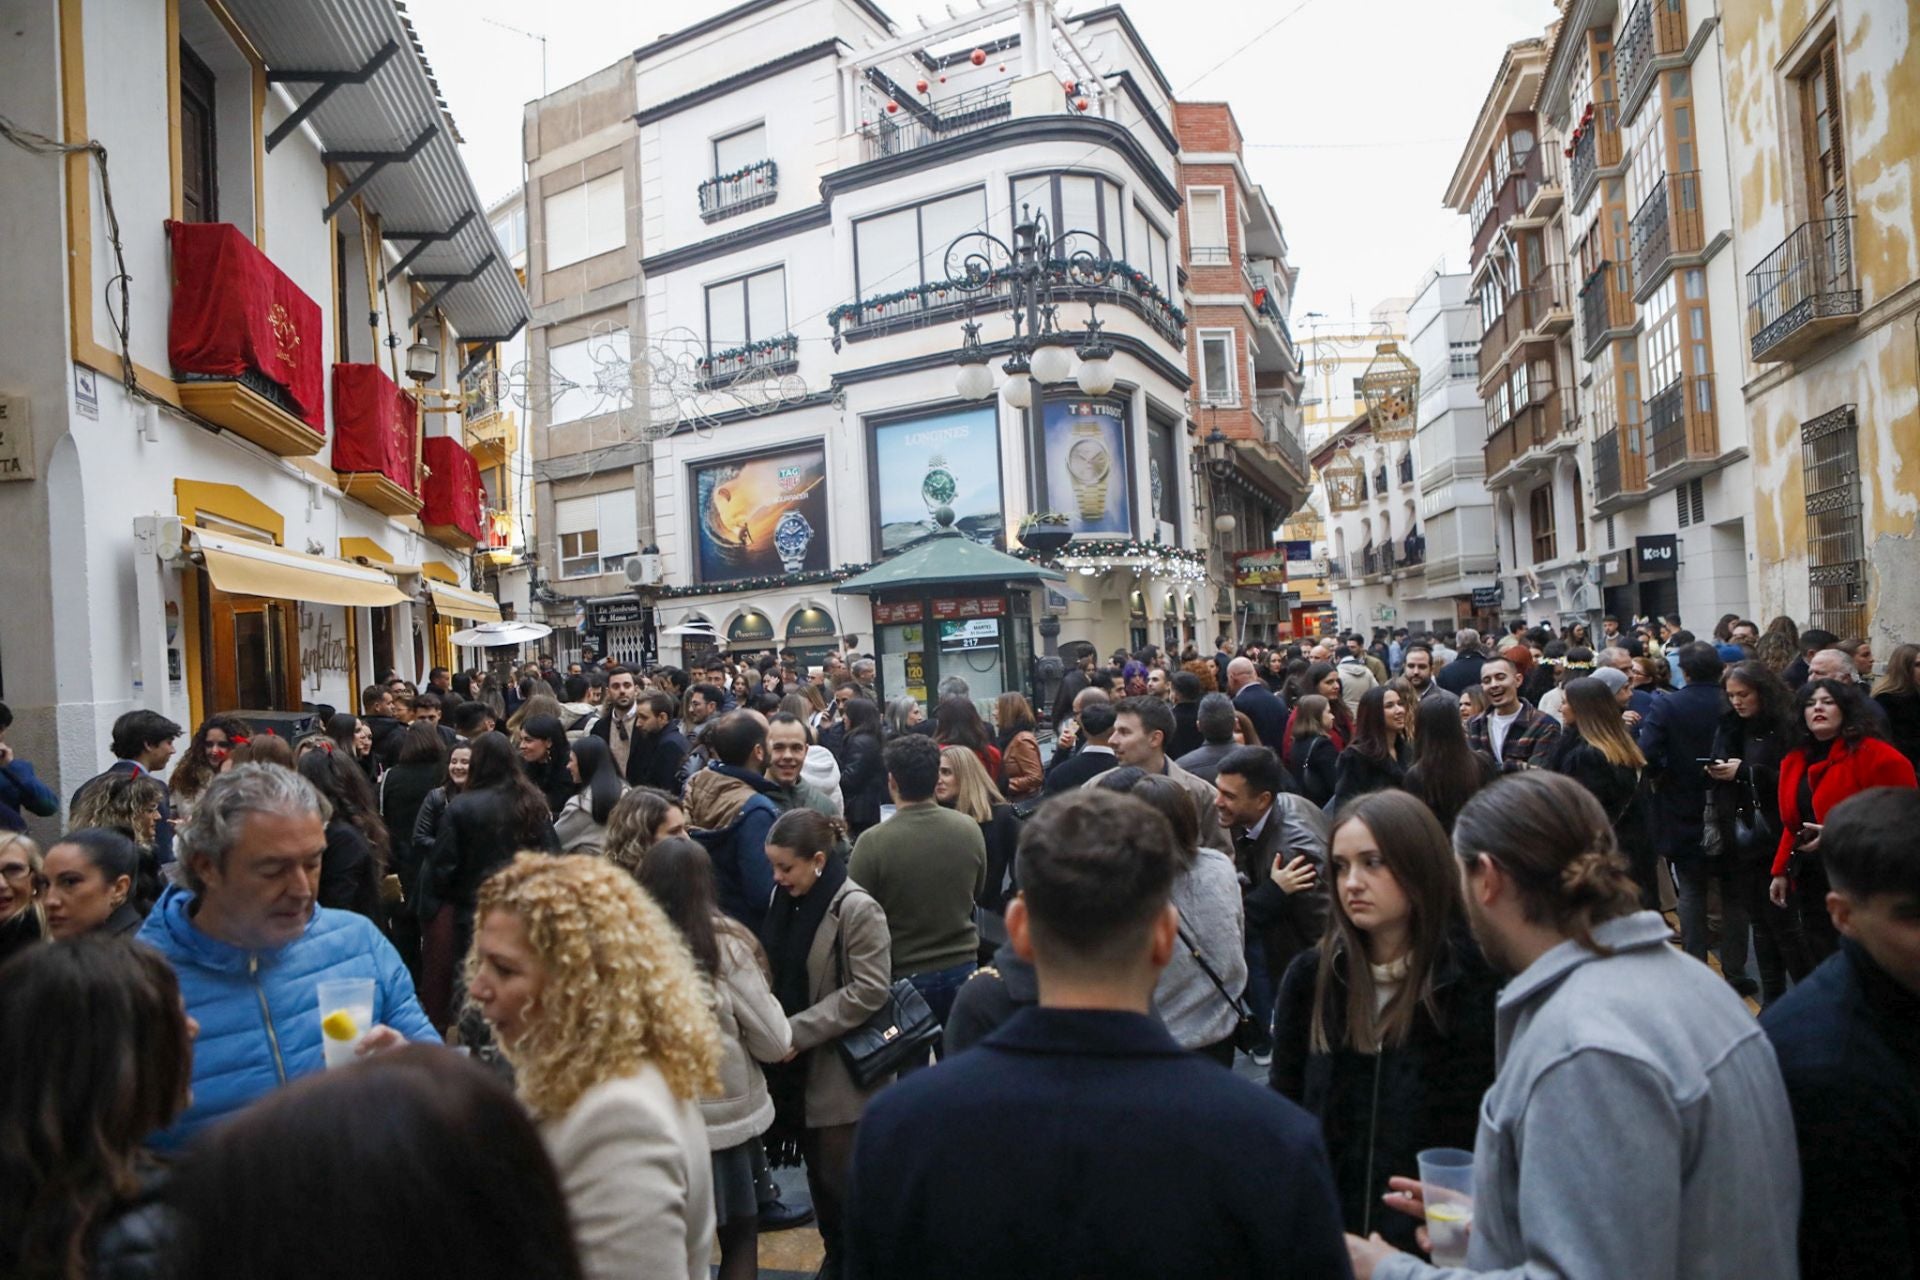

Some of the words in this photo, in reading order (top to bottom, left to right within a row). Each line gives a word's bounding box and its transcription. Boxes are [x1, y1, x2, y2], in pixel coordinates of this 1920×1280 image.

[1068, 404, 1078, 414] T
[1093, 404, 1122, 417] TISSOT
[904, 425, 969, 446] LONGINES
[779, 467, 800, 477] TAG
[963, 638, 979, 647] 217
